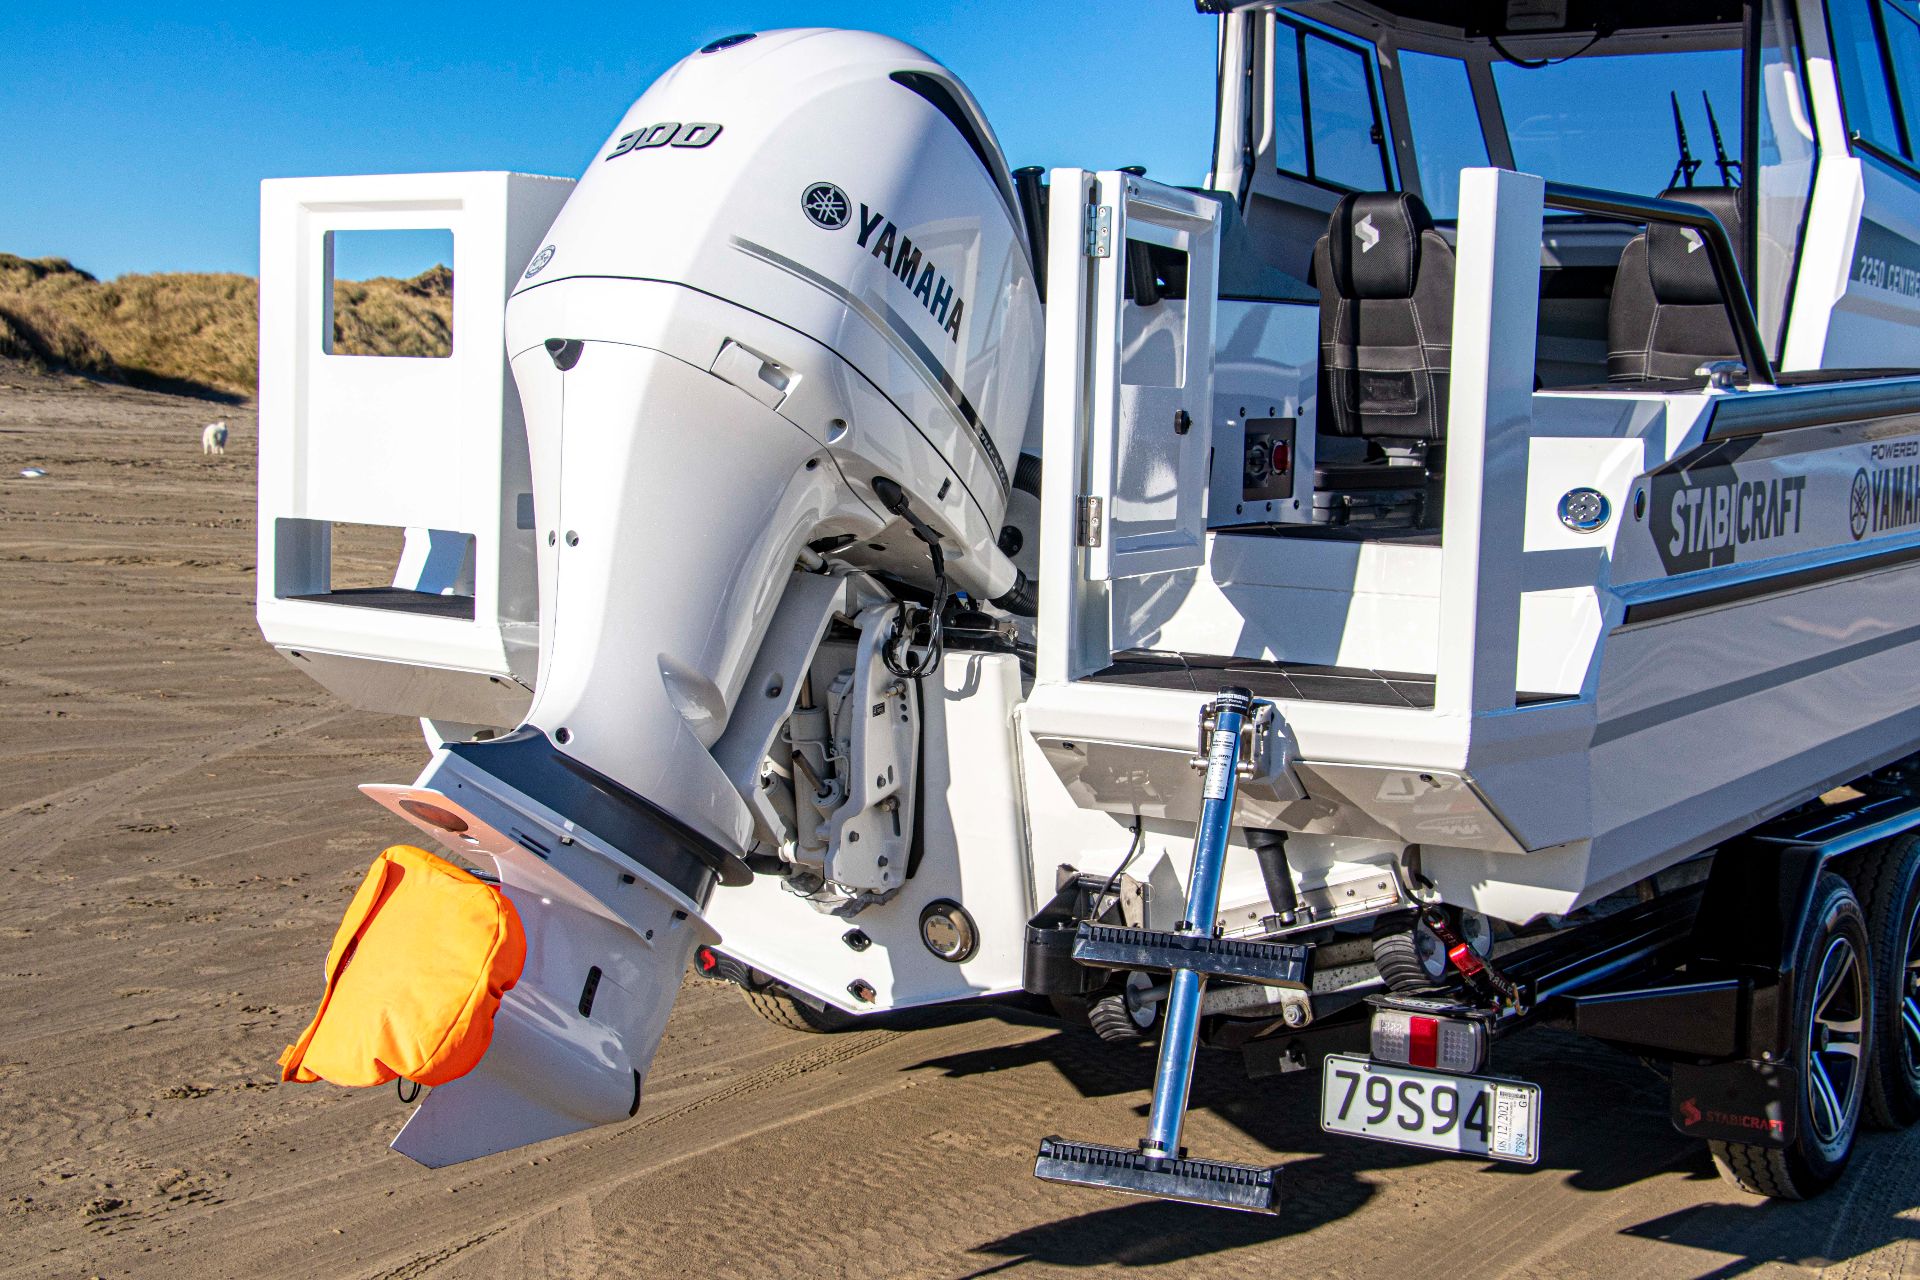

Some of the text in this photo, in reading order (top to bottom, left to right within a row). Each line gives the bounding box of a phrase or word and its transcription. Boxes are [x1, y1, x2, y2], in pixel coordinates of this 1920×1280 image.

[605, 121, 724, 162] 300
[856, 203, 965, 344] YAMAHA
[1860, 255, 1886, 289] 2250
[1871, 441, 1918, 460] POWERED
[1669, 475, 1806, 557] STABICRAFT
[1335, 1069, 1492, 1143] 79S94
[1706, 1111, 1785, 1133] STABICRAFT
